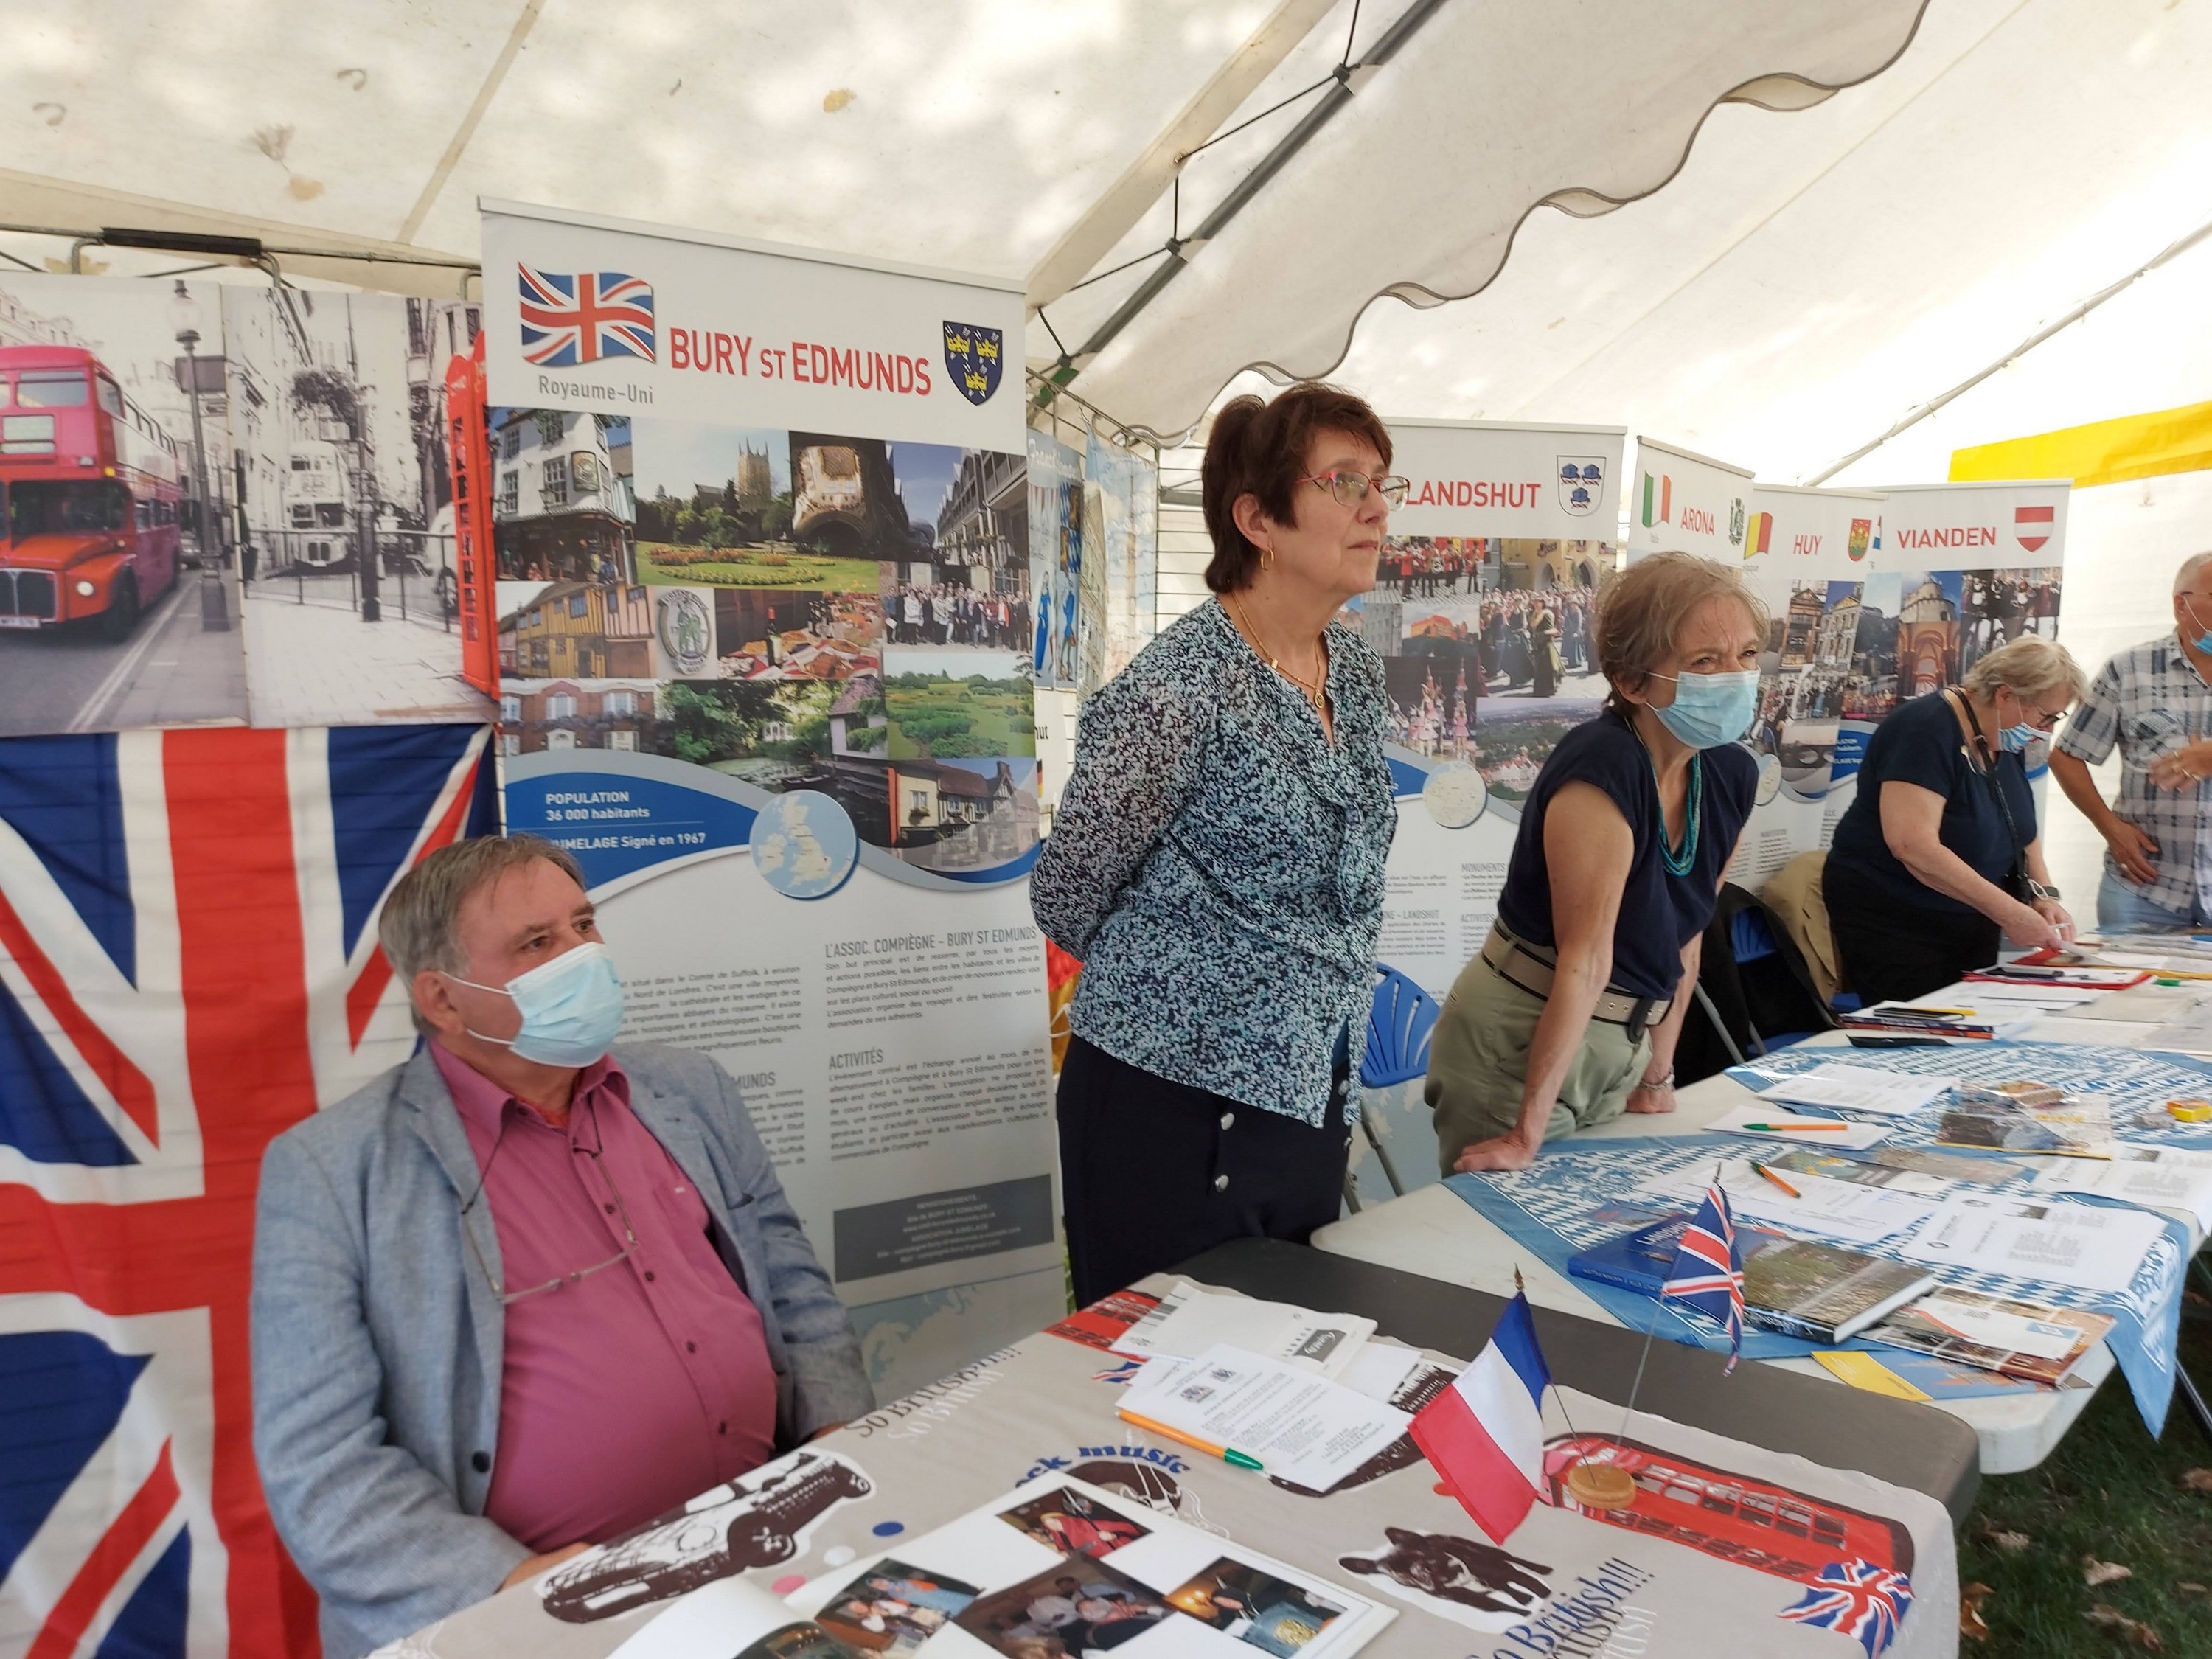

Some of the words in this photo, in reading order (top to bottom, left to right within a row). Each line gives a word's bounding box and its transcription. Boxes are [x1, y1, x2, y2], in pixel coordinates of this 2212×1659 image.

[670, 327, 752, 377] BURY
[760, 349, 787, 379] ST
[792, 342, 932, 396] EDMUNDS
[538, 375, 654, 405] Royaume-Uni
[1680, 506, 1715, 536] ARONA
[1793, 534, 1823, 555] HUY
[1897, 526, 1998, 549] VIANDEN
[546, 791, 630, 804] POPULATION
[546, 810, 563, 821] 36
[565, 808, 588, 821] 000
[591, 805, 650, 820] habitants
[552, 836, 619, 850] UMELAGE
[621, 834, 656, 849] Signé
[658, 834, 675, 845] en
[677, 832, 706, 844] 1967
[825, 940, 872, 959] L'ASSOC.
[874, 933, 936, 953] COMPIÈGNE
[947, 931, 974, 947] BURY
[976, 930, 990, 945] ST
[992, 925, 1037, 943] EDMUNDS
[829, 1047, 884, 1070] ACTIVITÉS
[730, 1071, 776, 1089] MUNDS
[1015, 1455, 1072, 1489] ck
[1078, 1444, 1191, 1473] music
